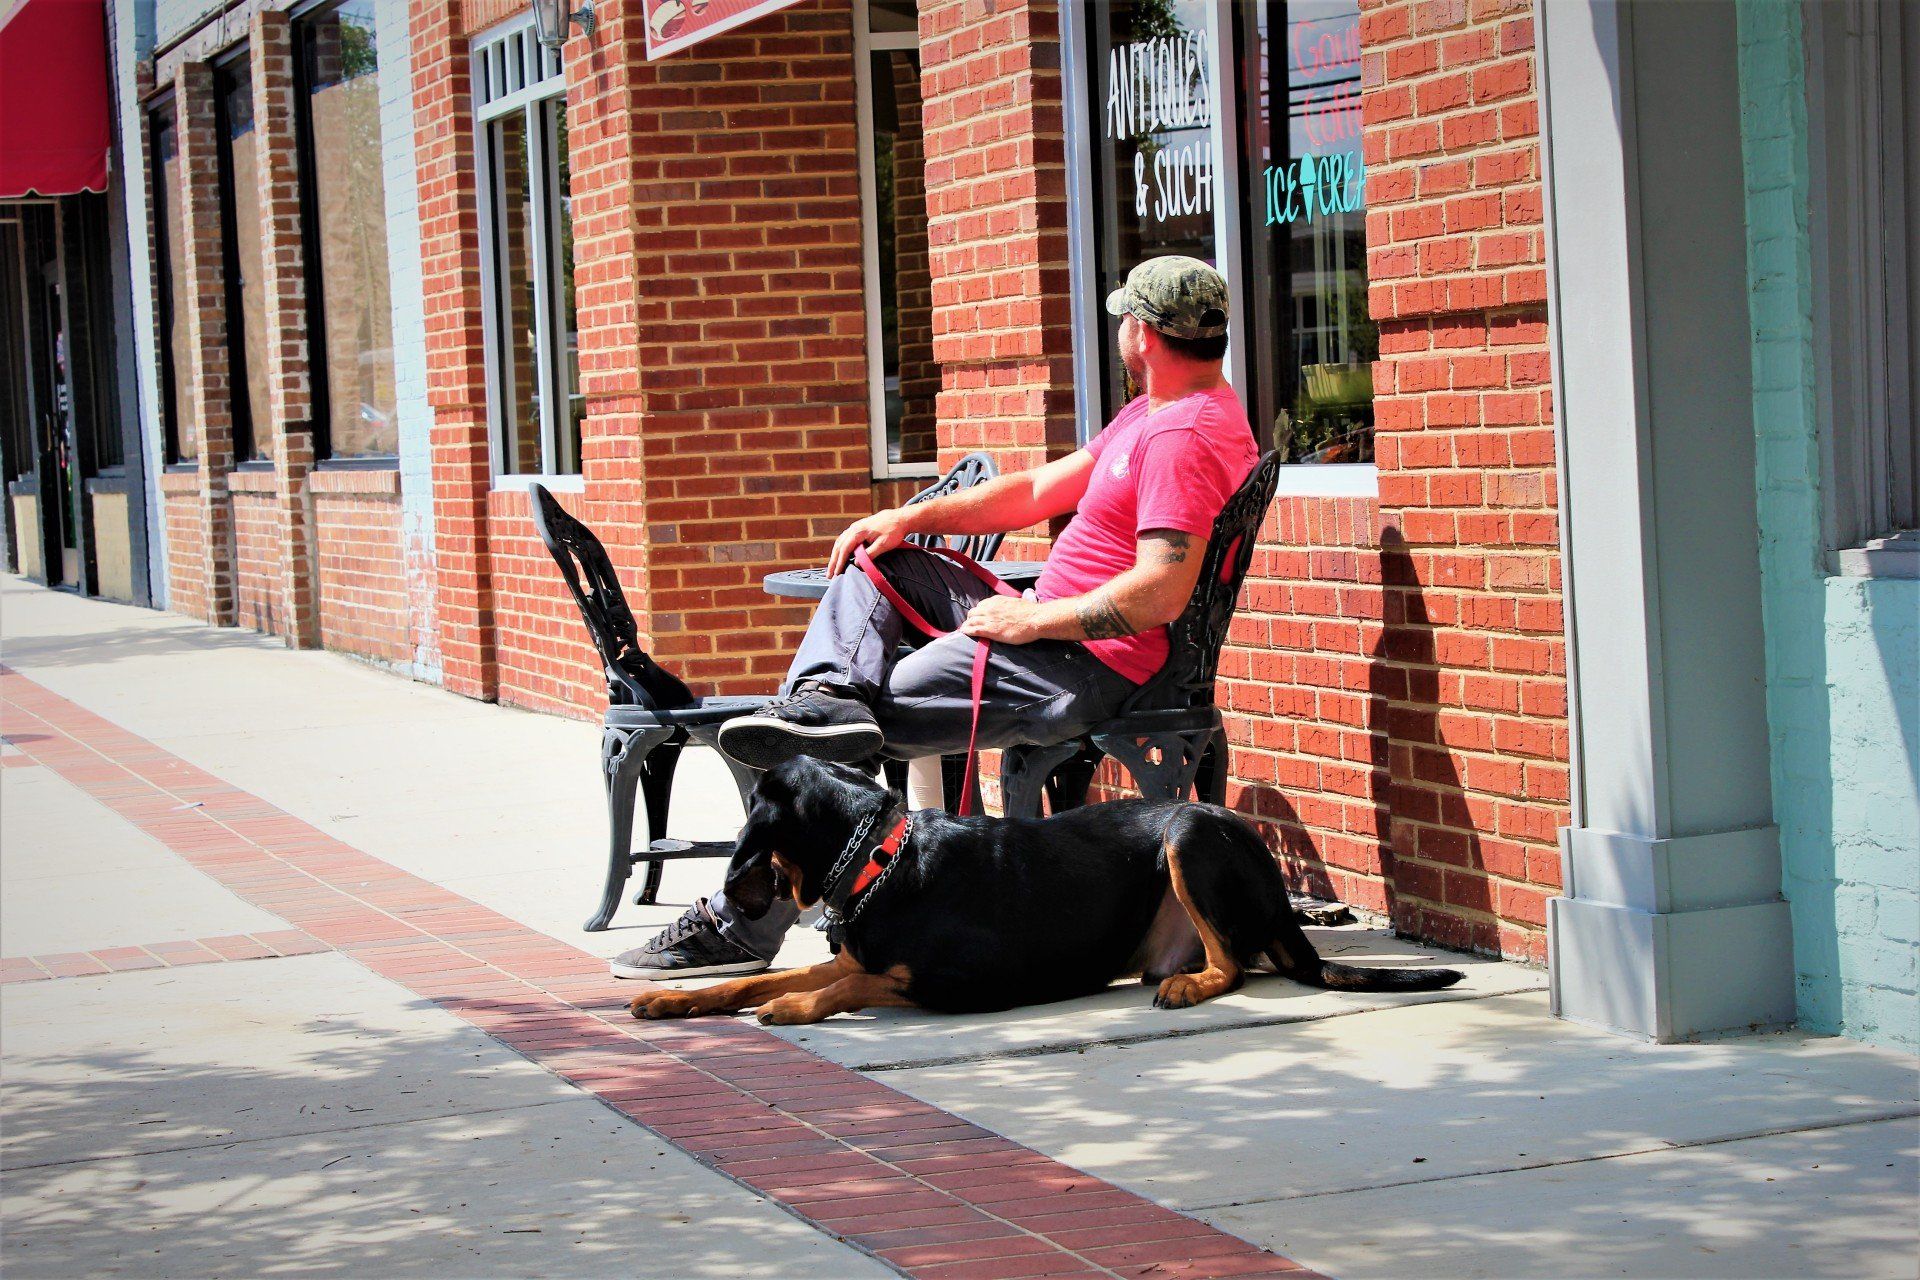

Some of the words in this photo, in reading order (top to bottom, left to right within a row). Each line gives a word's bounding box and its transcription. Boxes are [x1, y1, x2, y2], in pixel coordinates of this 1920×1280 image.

[1106, 29, 1210, 140] ANTIQUES
[1135, 151, 1149, 217] &
[1154, 141, 1213, 223] SUCH
[1263, 163, 1299, 226] ICE
